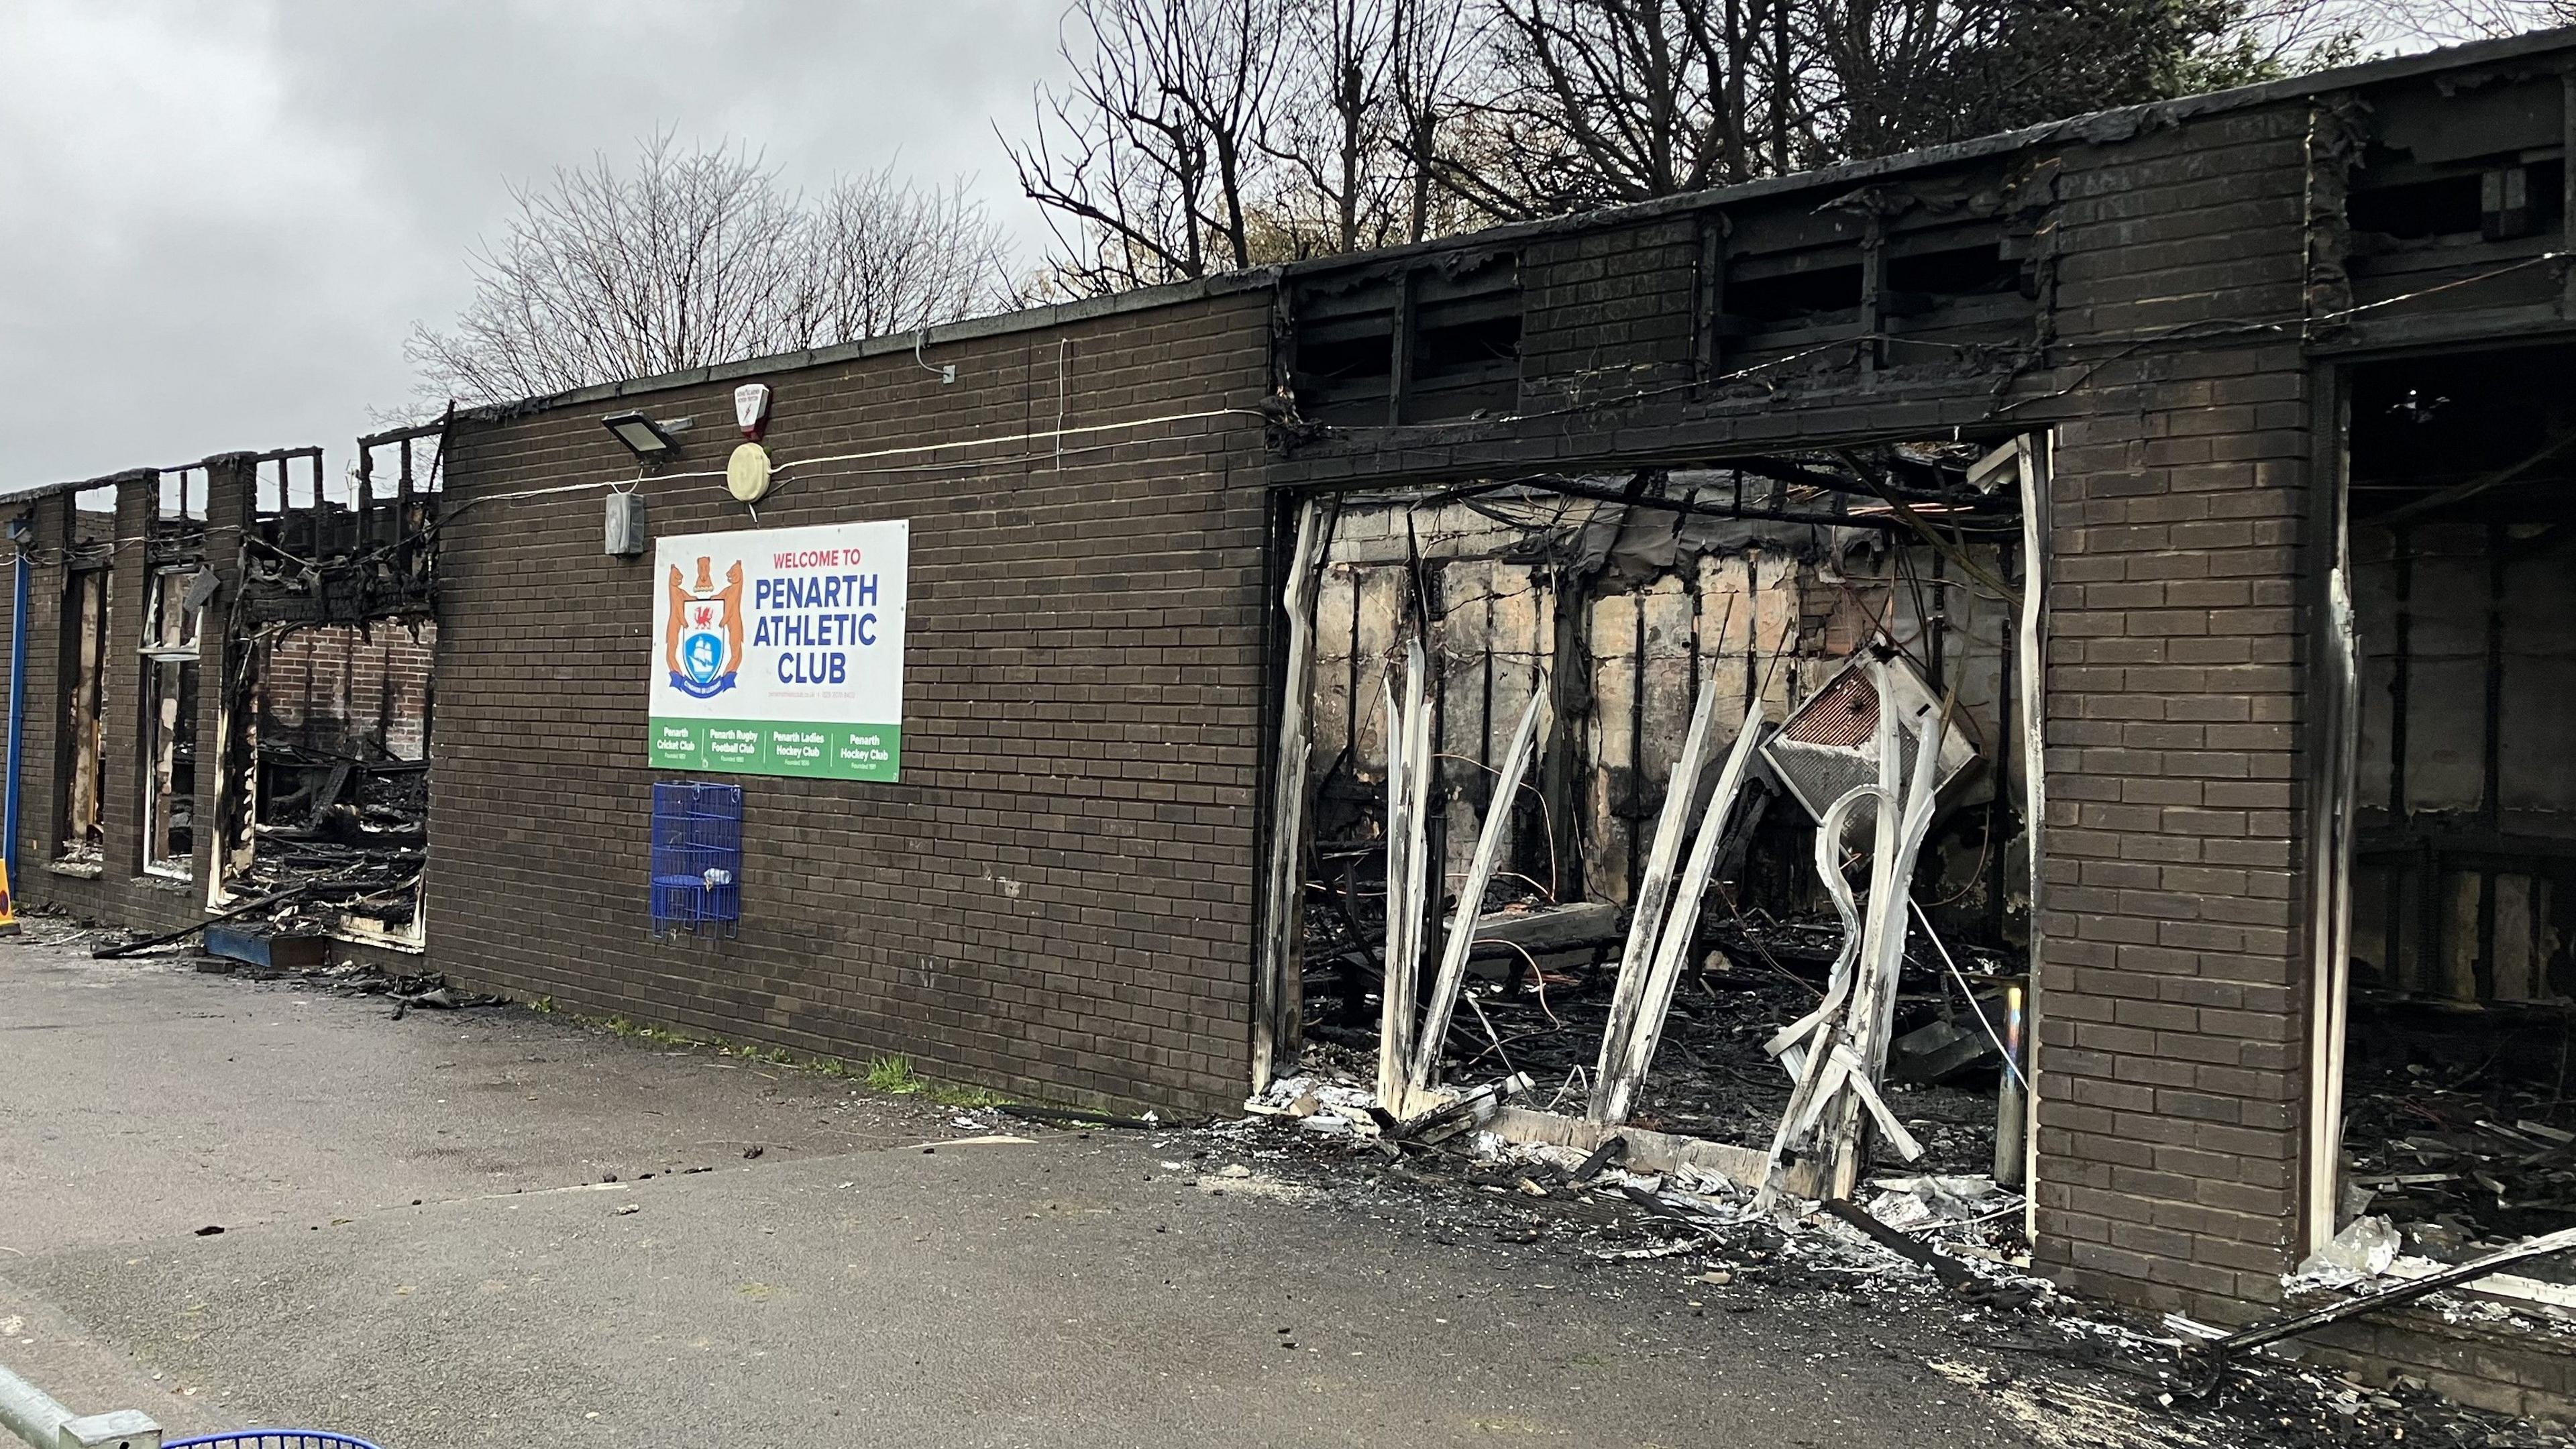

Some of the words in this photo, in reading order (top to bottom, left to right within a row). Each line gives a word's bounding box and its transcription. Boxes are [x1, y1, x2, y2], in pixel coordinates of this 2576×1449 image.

[773, 550, 839, 569] WELCOME
[843, 549, 861, 566] TO
[756, 574, 877, 610] PENARTH
[753, 613, 877, 646] ATHLETIC
[778, 652, 846, 684] CLUB
[664, 727, 688, 737] Penarth
[710, 729, 735, 739] Penarth
[736, 730, 758, 743] Rugby
[773, 731, 800, 742] Penarth
[801, 732, 824, 743] Ladies
[657, 739, 679, 750] Cricket
[680, 741, 695, 751] Club
[850, 734, 880, 745] Penarth
[712, 742, 738, 753] Football
[739, 743, 755, 753] Club
[776, 745, 802, 759] Hockey
[803, 746, 820, 757] Club
[841, 748, 869, 762] Hockey
[870, 749, 888, 761] Club
